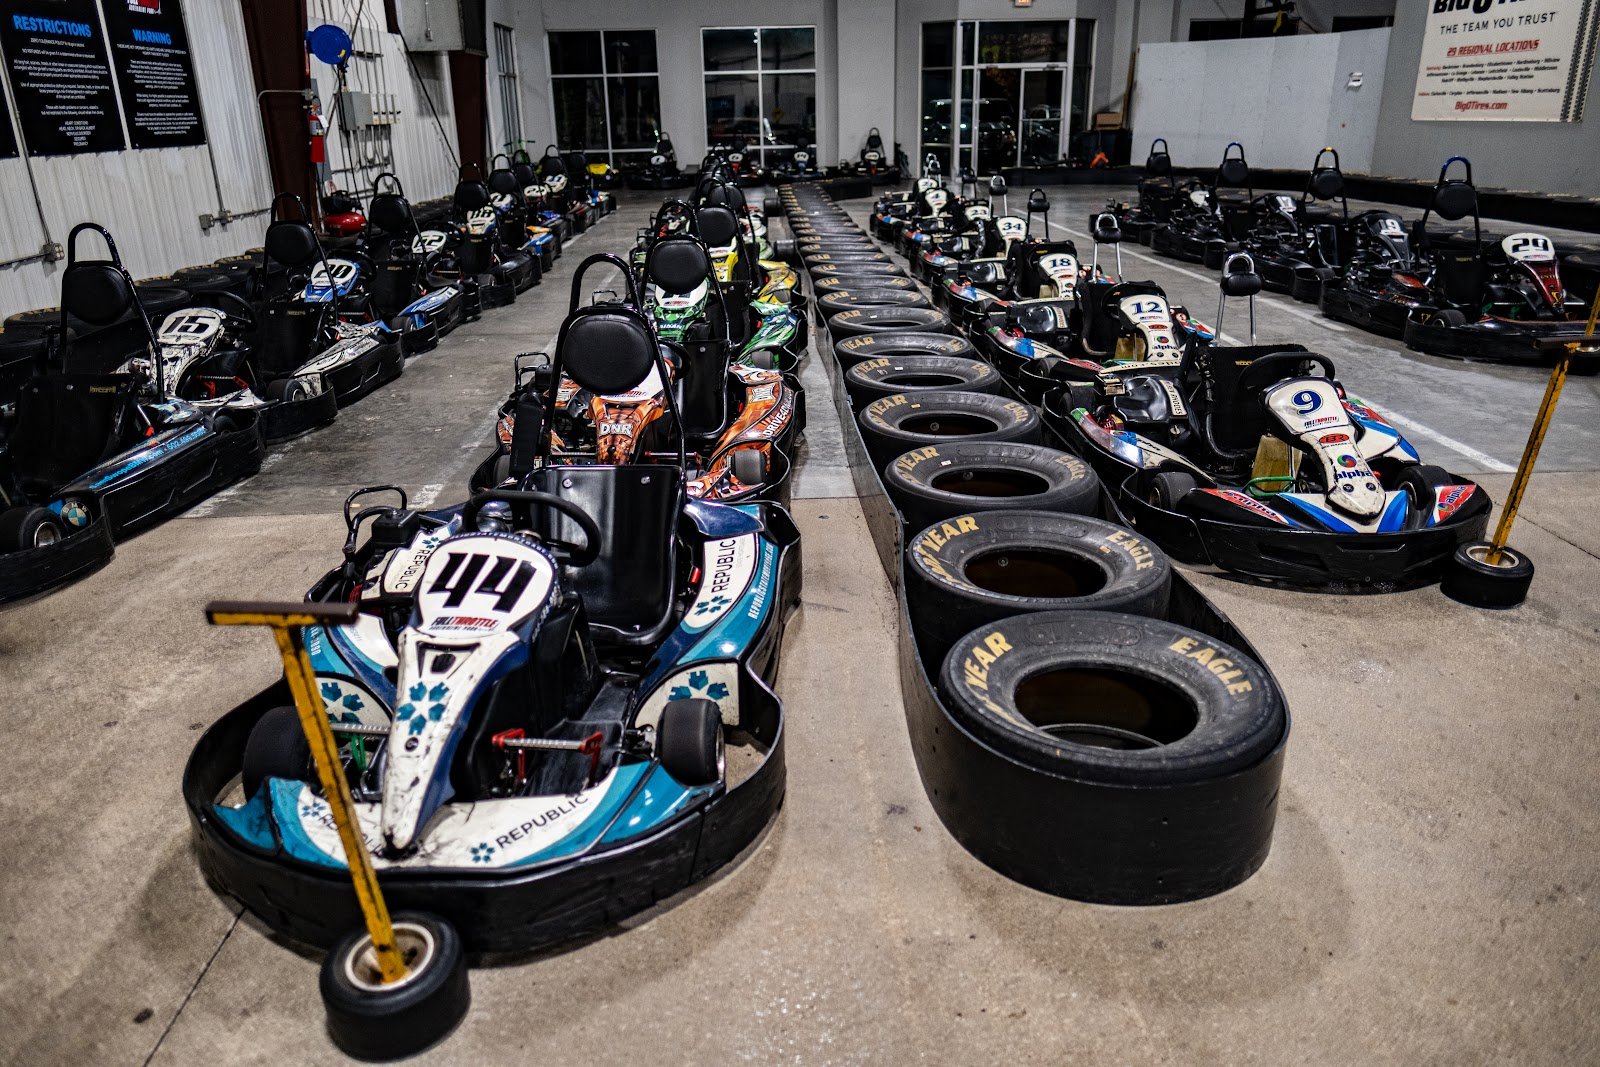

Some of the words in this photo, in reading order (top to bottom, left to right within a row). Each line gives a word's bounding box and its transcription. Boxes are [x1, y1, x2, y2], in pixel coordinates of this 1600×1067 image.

[13, 15, 92, 37] RESTRICTIONS
[1440, 24, 1458, 35] THE
[1462, 20, 1489, 32] TEAM
[1493, 17, 1514, 28] YOU
[1518, 11, 1557, 26] TRUST
[132, 28, 172, 45] WARNING
[1446, 47, 1457, 56] 29
[1458, 44, 1493, 56] REGIONAL
[1495, 40, 1540, 53] LOCATIONS
[1454, 100, 1508, 112] BigOTires.com
[1002, 222, 1023, 232] 34
[1379, 218, 1401, 230] 19
[1048, 258, 1072, 268] 18
[1131, 301, 1163, 316] 12
[161, 315, 217, 335] 15
[1291, 388, 1323, 415] 9
[600, 422, 634, 436] DNR
[1334, 469, 1376, 480] alpha
[1105, 530, 1154, 571] EAGLE
[395, 549, 431, 590] REPUBLIC
[711, 539, 737, 594] REPUBLIC
[426, 552, 538, 614] 44
[1168, 636, 1253, 696] EAGLE
[495, 794, 590, 849] REPUBLIC
